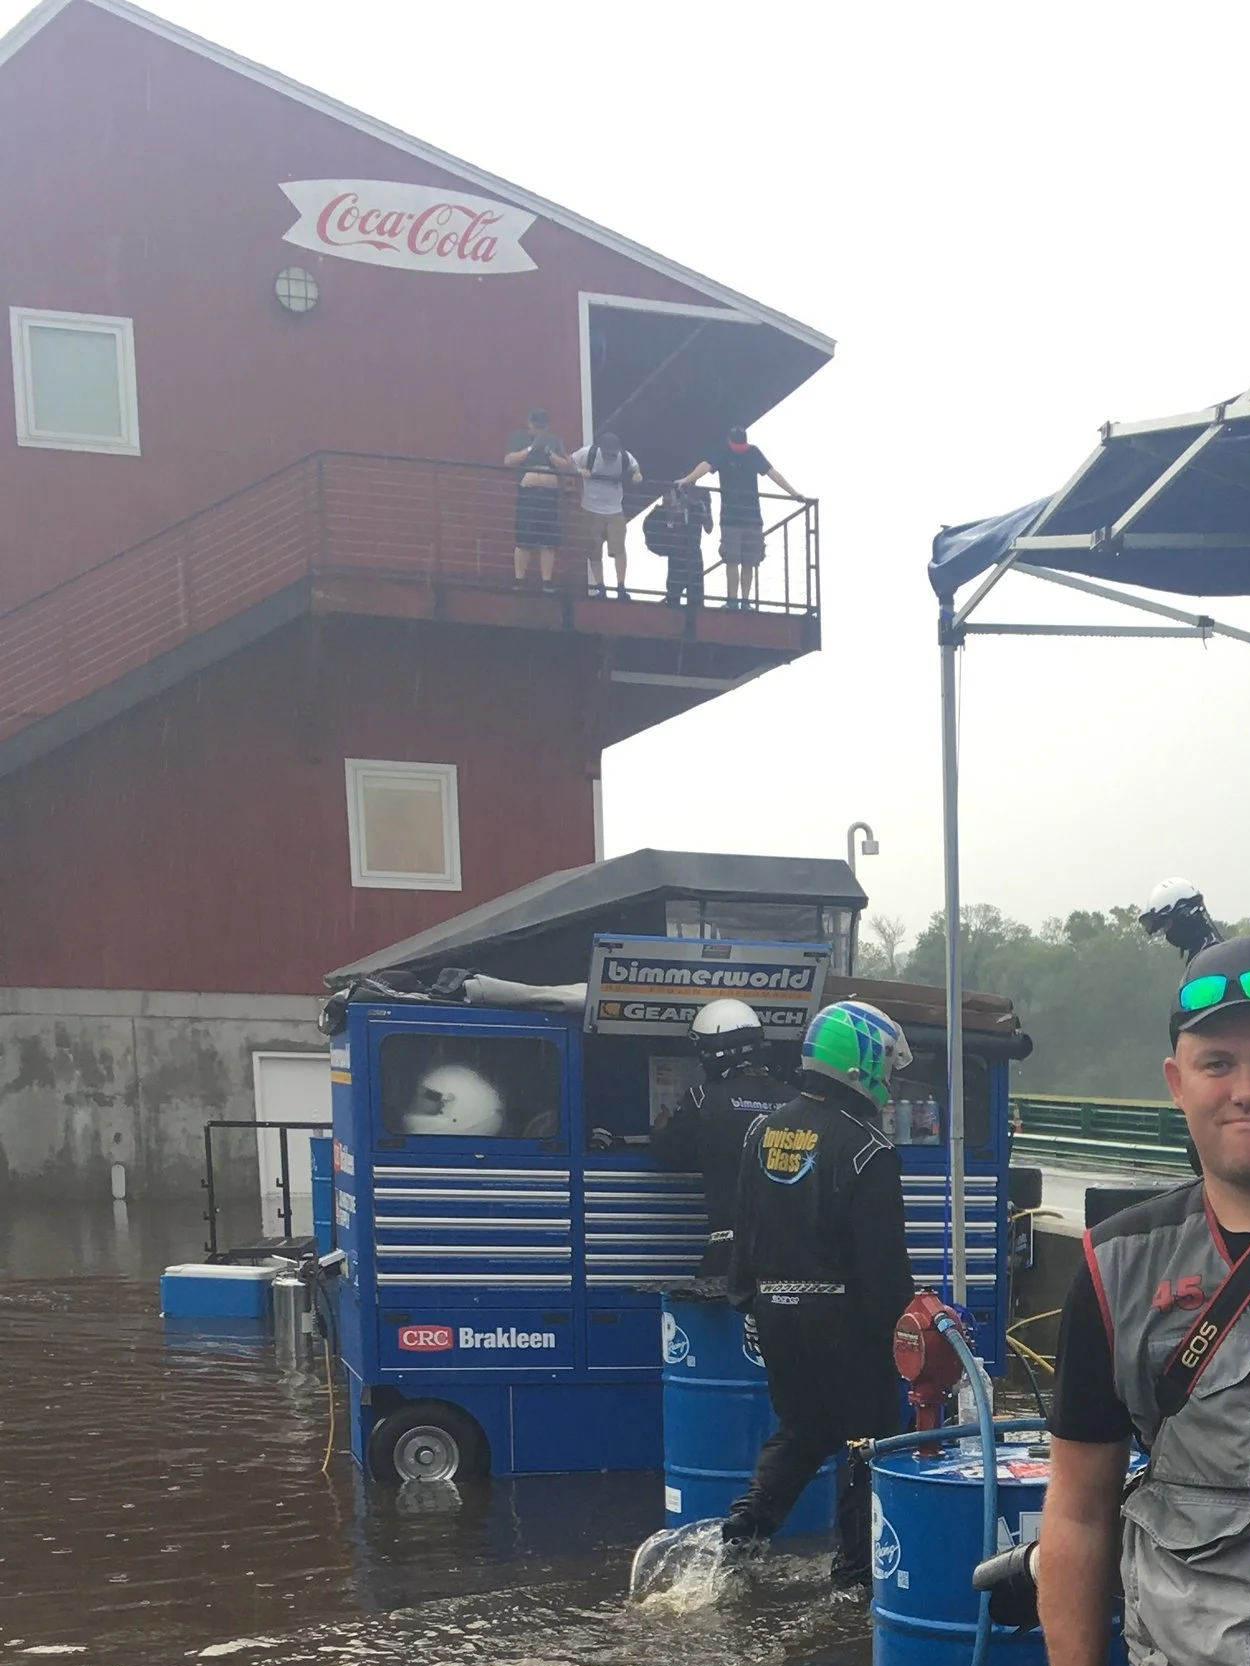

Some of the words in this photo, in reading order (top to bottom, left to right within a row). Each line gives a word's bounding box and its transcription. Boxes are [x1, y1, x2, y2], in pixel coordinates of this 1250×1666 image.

[316, 192, 504, 262] Coca-Cola
[608, 960, 811, 990] bimmerworld
[762, 1126, 819, 1151] Invisible
[766, 1147, 803, 1173] Glass
[402, 1329, 449, 1347] CRC
[1181, 1320, 1218, 1369] EOS
